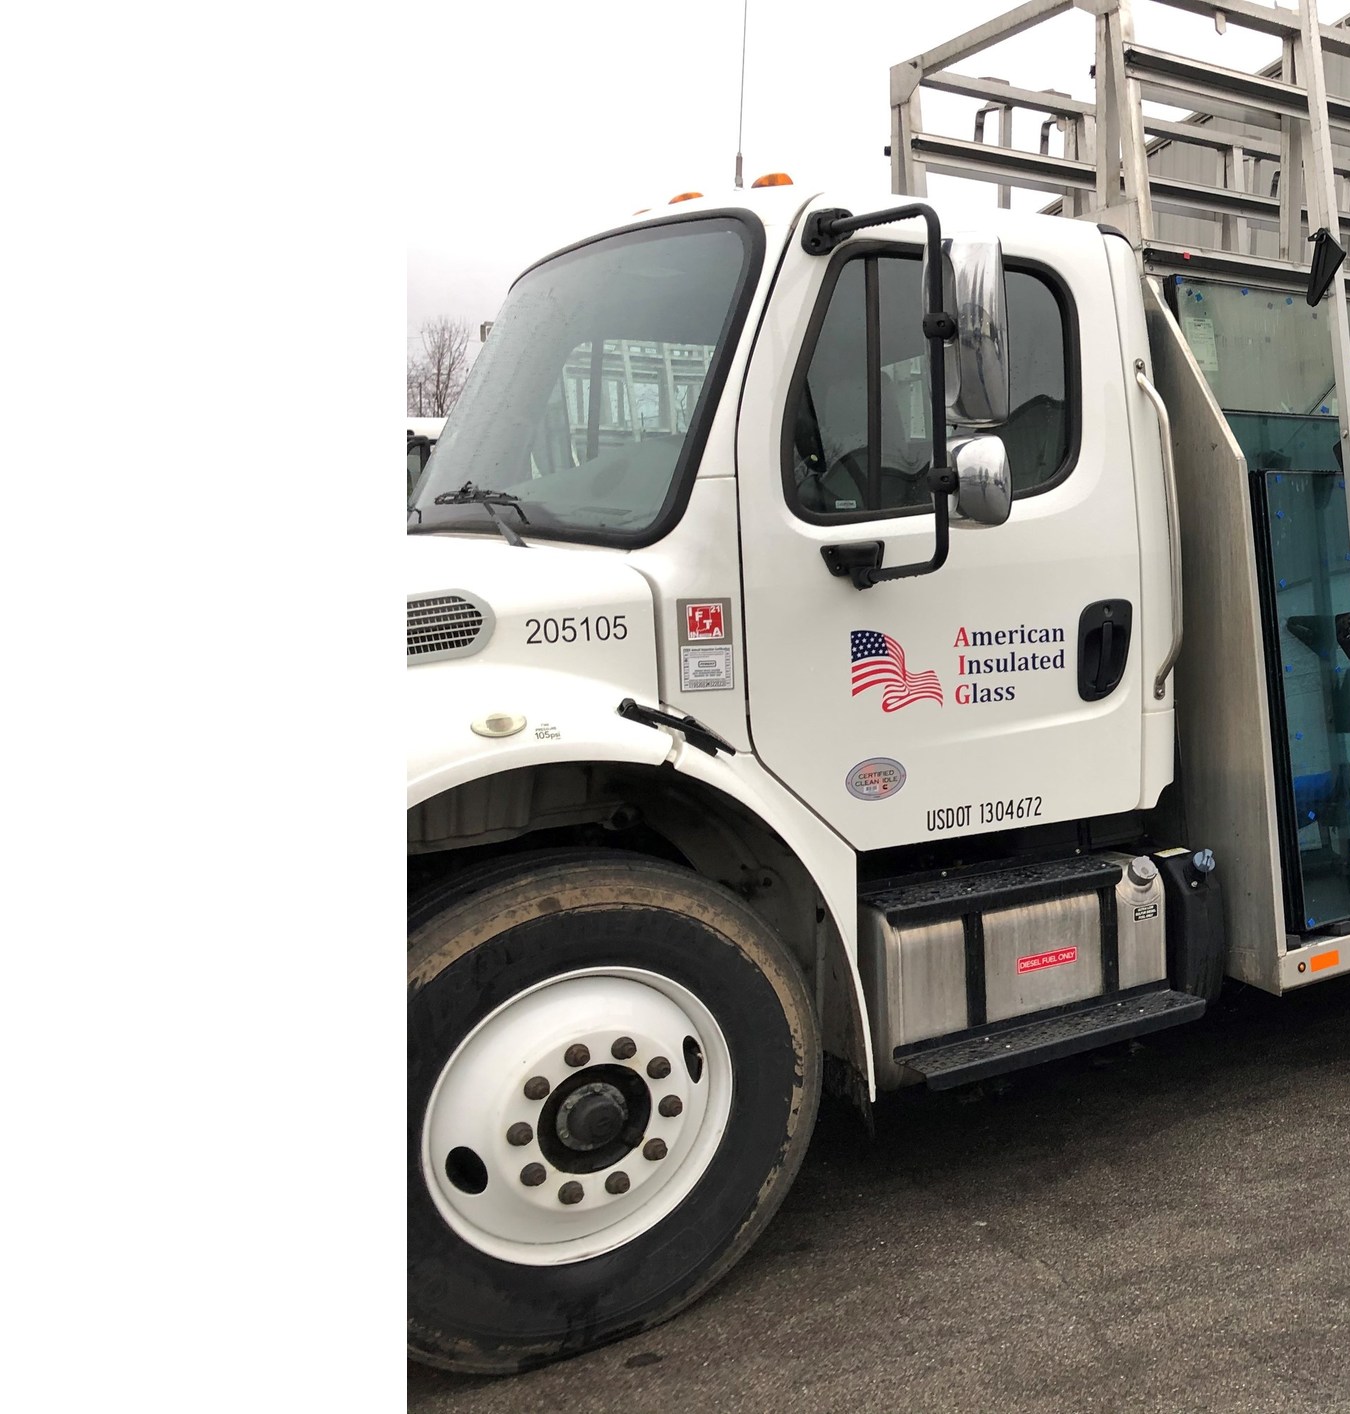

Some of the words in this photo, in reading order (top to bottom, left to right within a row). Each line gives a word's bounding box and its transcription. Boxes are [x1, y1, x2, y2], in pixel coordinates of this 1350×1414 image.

[710, 605, 721, 613] 21
[525, 615, 628, 644] 205105
[953, 624, 1065, 648] American
[958, 649, 1065, 675] Insulated
[954, 683, 1016, 705] Glass
[535, 731, 561, 740] 105psi
[854, 779, 880, 787] CLEAN
[882, 775, 898, 784] IDLE
[858, 769, 895, 780] CERTIFIED
[926, 805, 973, 832] USDOT
[980, 796, 1043, 824] 1304672
[1020, 958, 1042, 970] DIESEL
[1042, 955, 1058, 965] FUEL
[1057, 951, 1075, 961] ONLY
